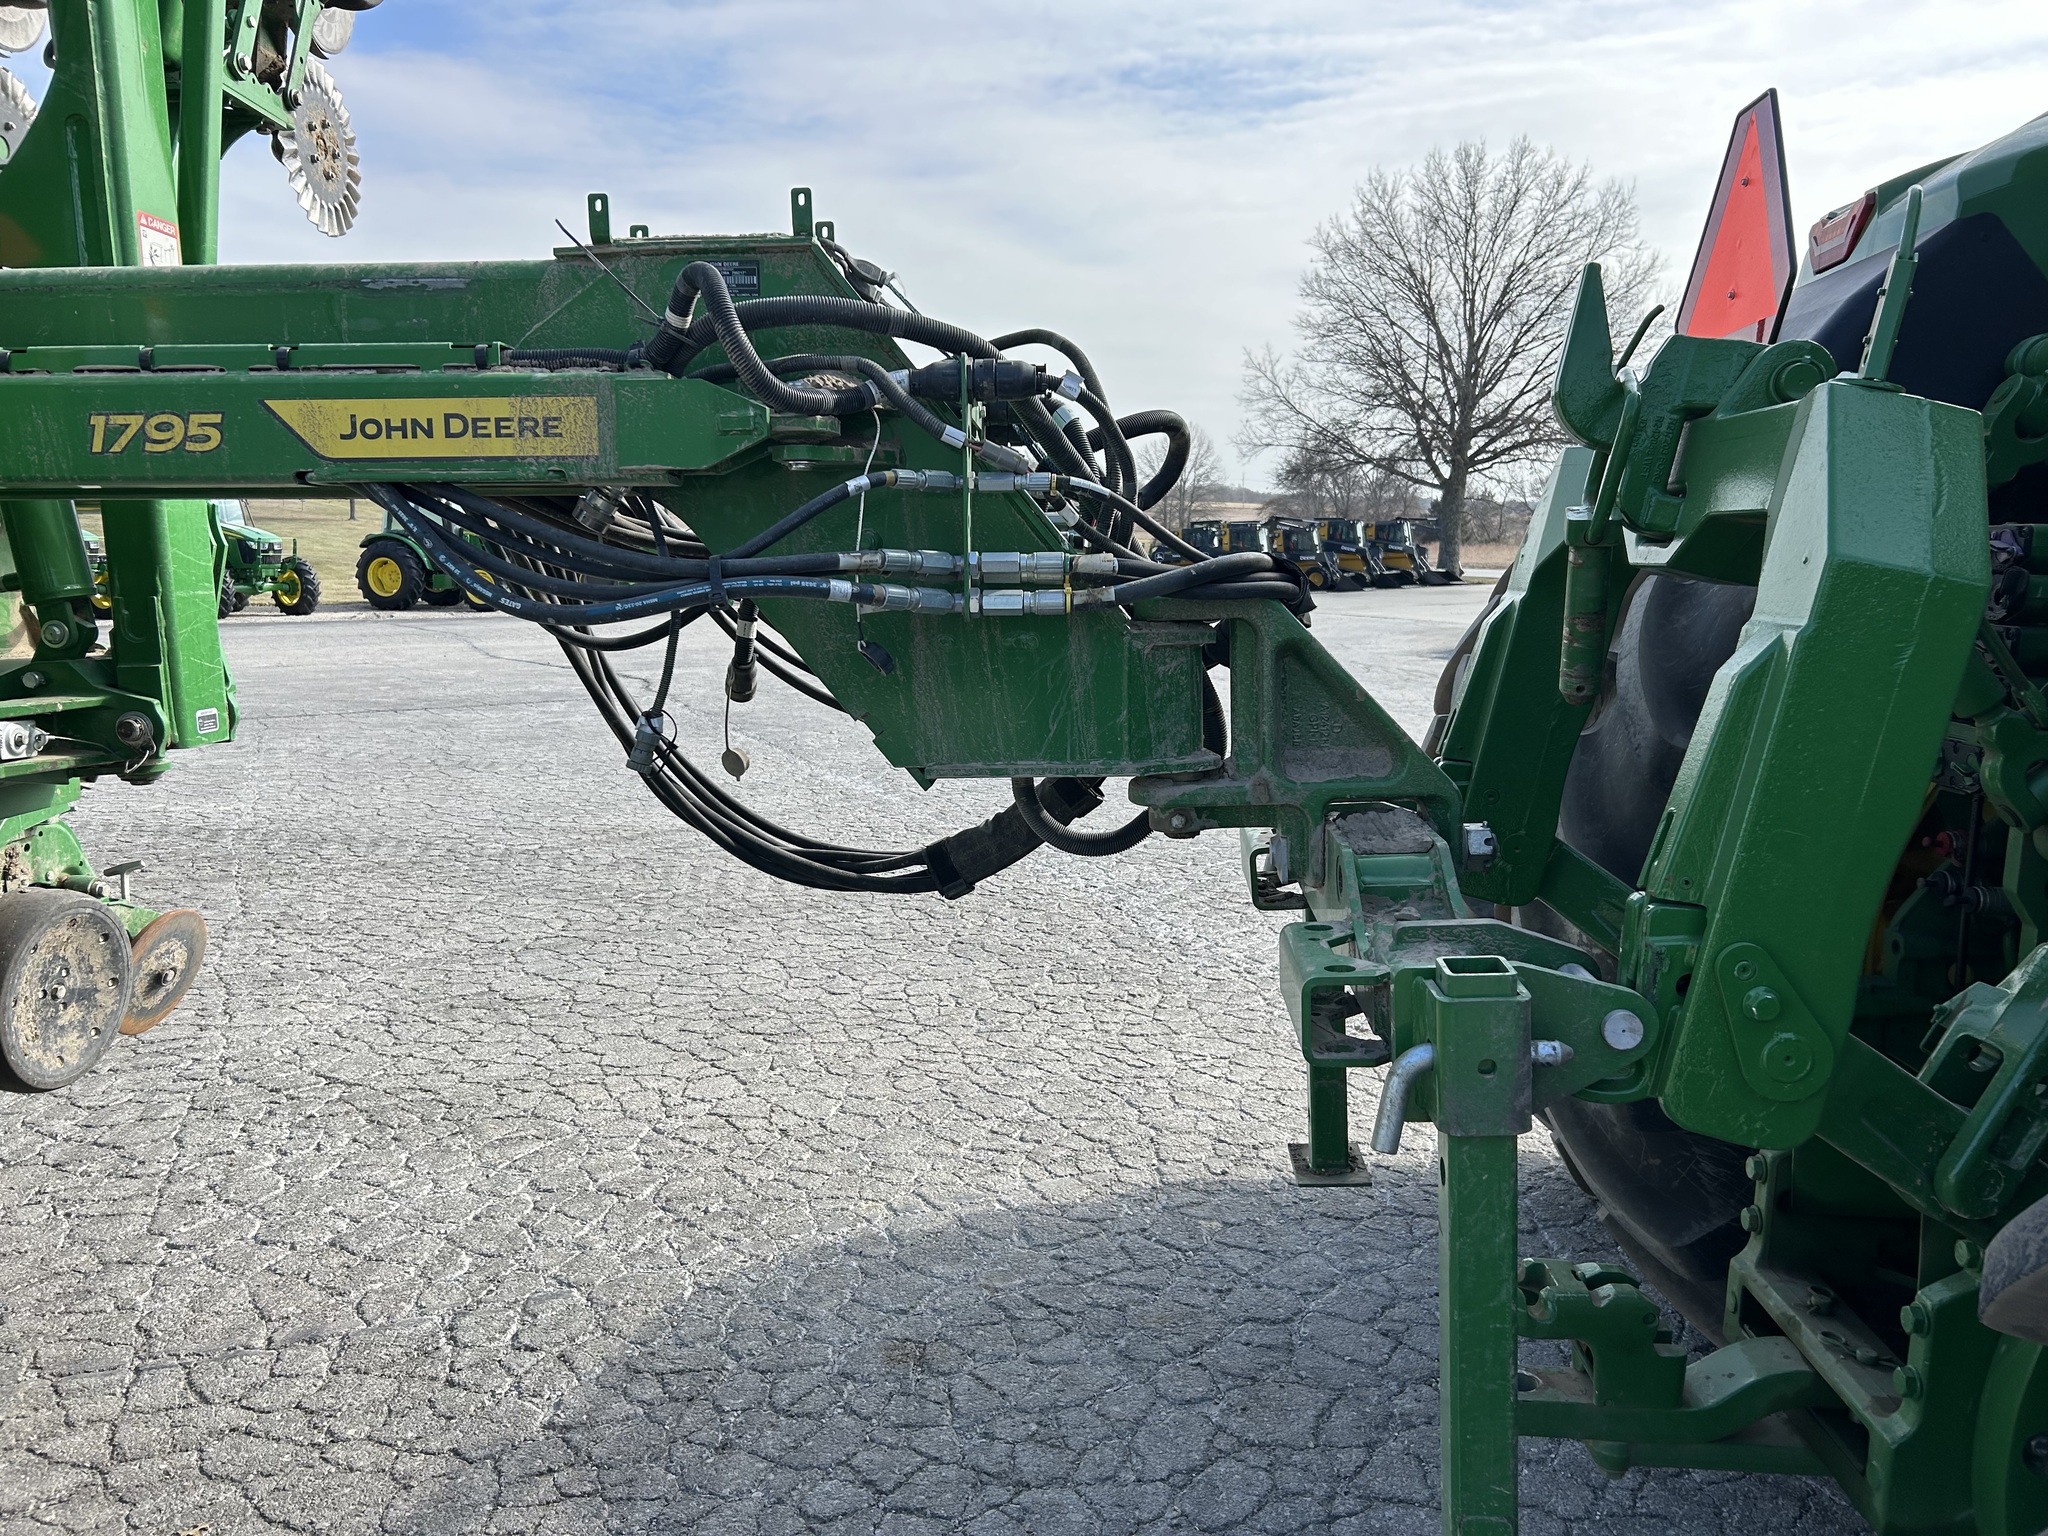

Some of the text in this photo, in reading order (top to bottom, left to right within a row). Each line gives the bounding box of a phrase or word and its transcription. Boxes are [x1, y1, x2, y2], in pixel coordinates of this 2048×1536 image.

[147, 216, 176, 236] DANGER
[89, 412, 223, 453] 1795
[340, 412, 563, 440] JOHN DEERE
[500, 597, 522, 610] GATES
